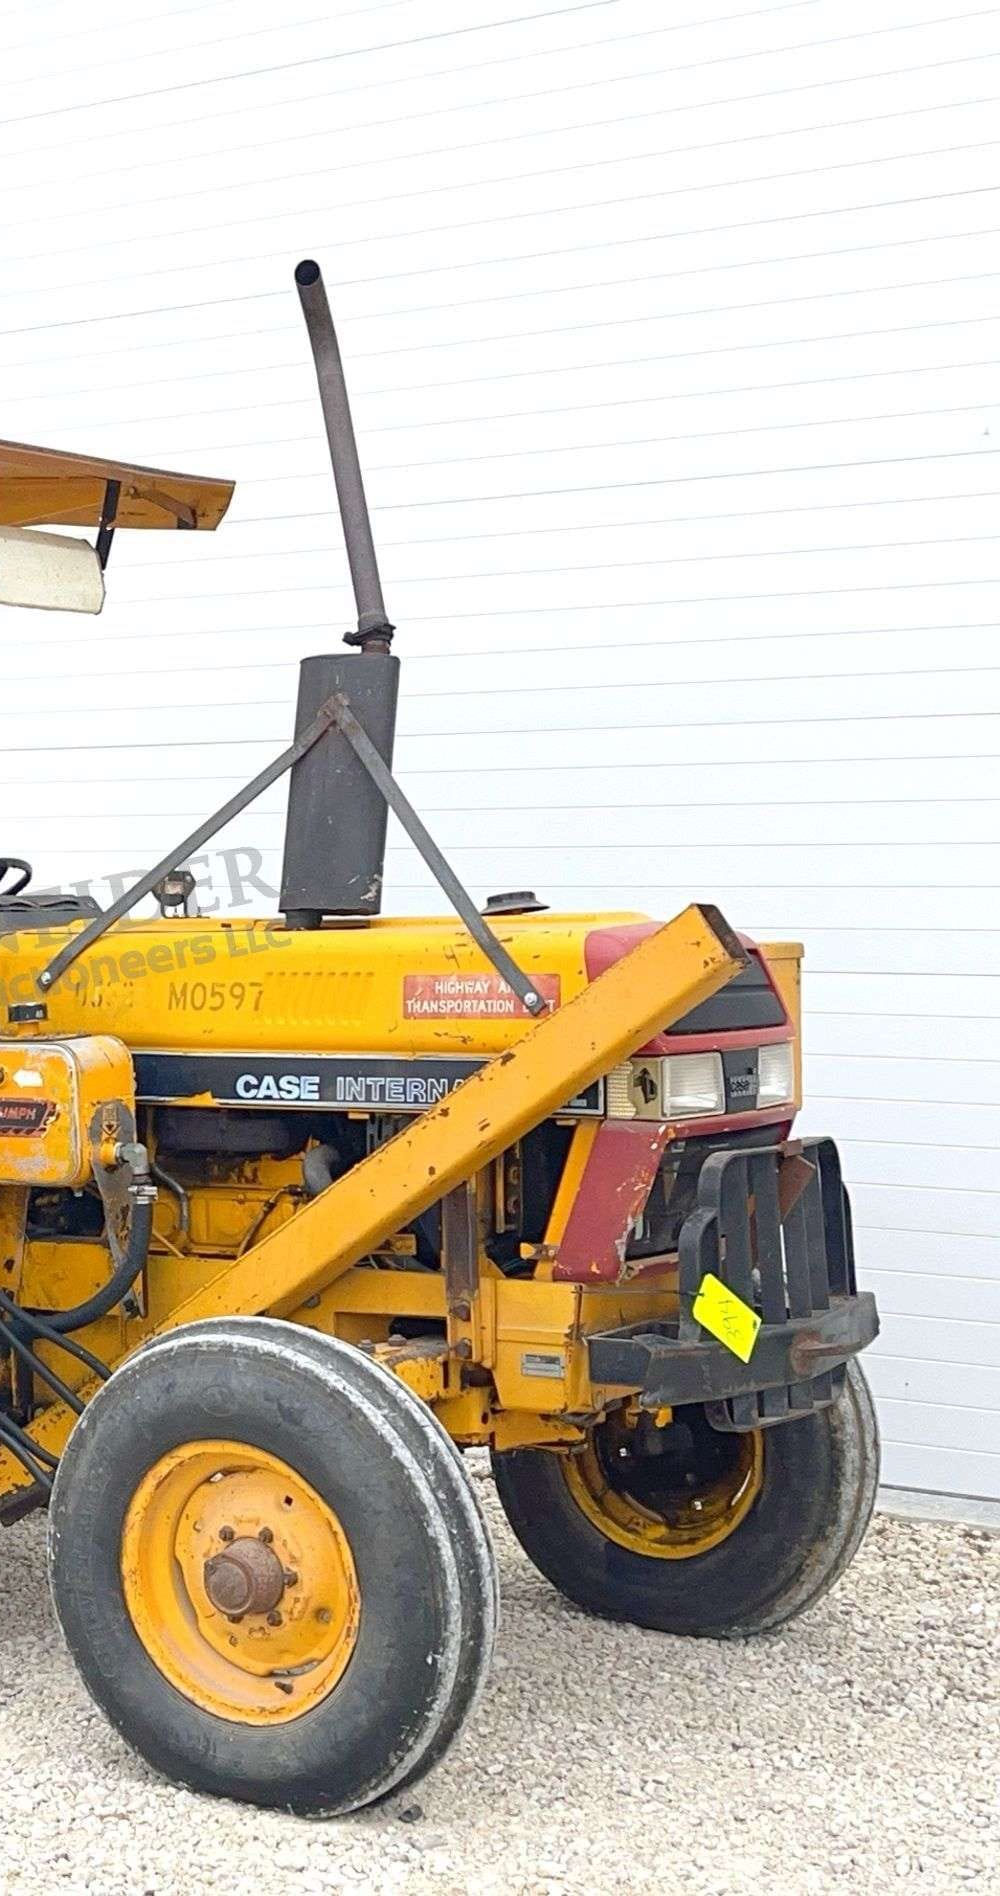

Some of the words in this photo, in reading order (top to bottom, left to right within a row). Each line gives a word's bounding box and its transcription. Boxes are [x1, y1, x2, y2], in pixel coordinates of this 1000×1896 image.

[434, 981, 491, 994] HIGHWAY
[406, 1000, 515, 1013] TRANSPORTATION
[236, 1074, 321, 1100] CASE
